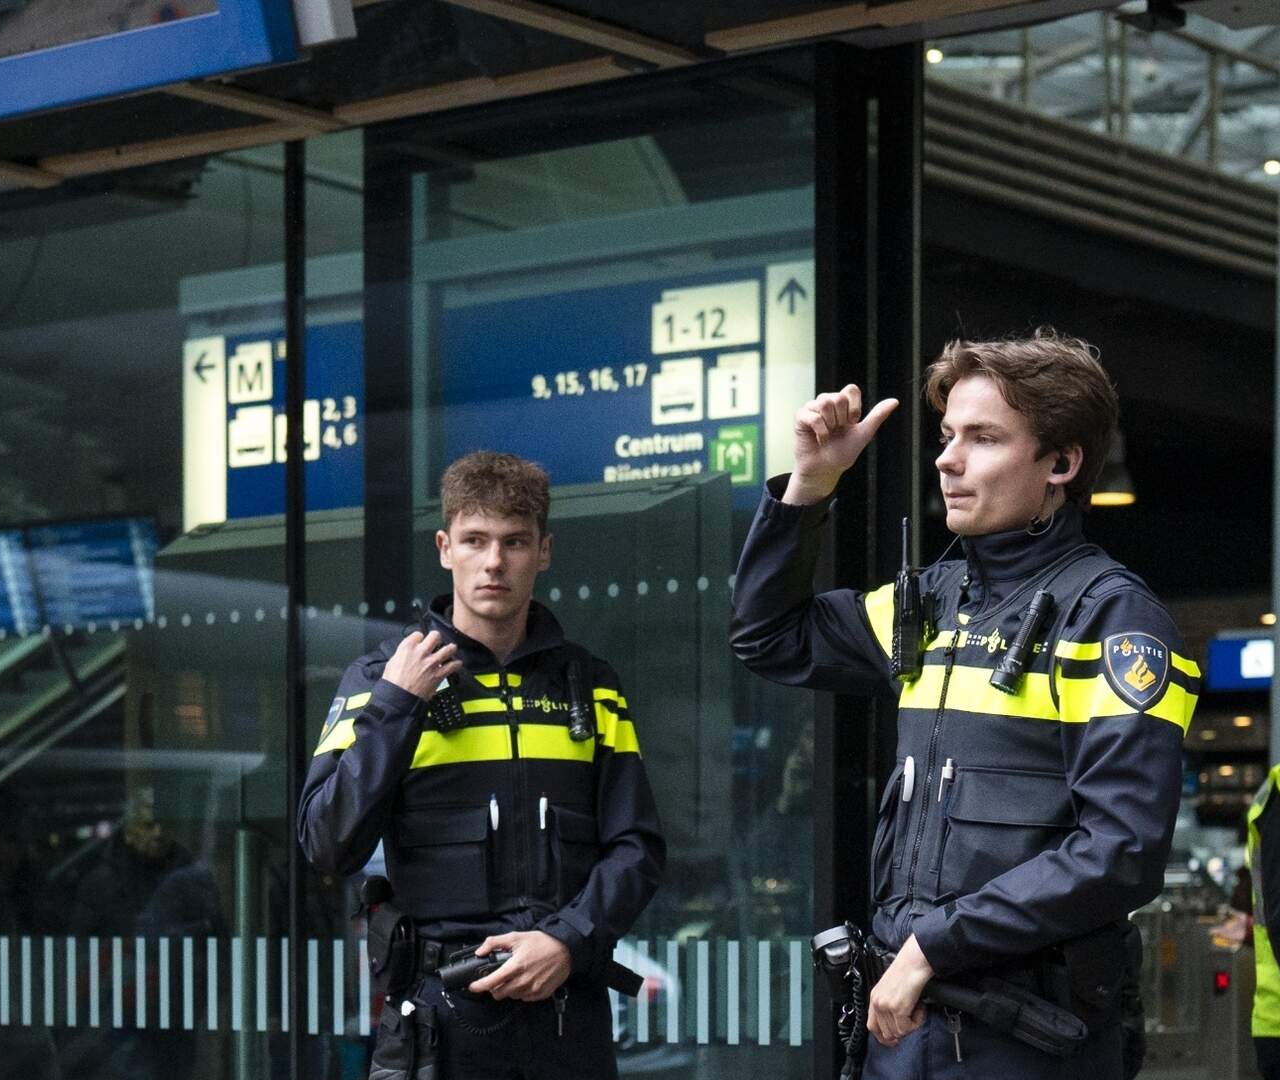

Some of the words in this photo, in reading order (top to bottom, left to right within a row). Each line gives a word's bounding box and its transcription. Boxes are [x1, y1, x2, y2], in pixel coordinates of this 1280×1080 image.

[662, 307, 727, 344] 1-12
[237, 361, 264, 393] M
[623, 363, 648, 387] 17
[342, 423, 358, 446] 6
[615, 432, 704, 458] Centrum
[1113, 640, 1163, 659] POLITIE
